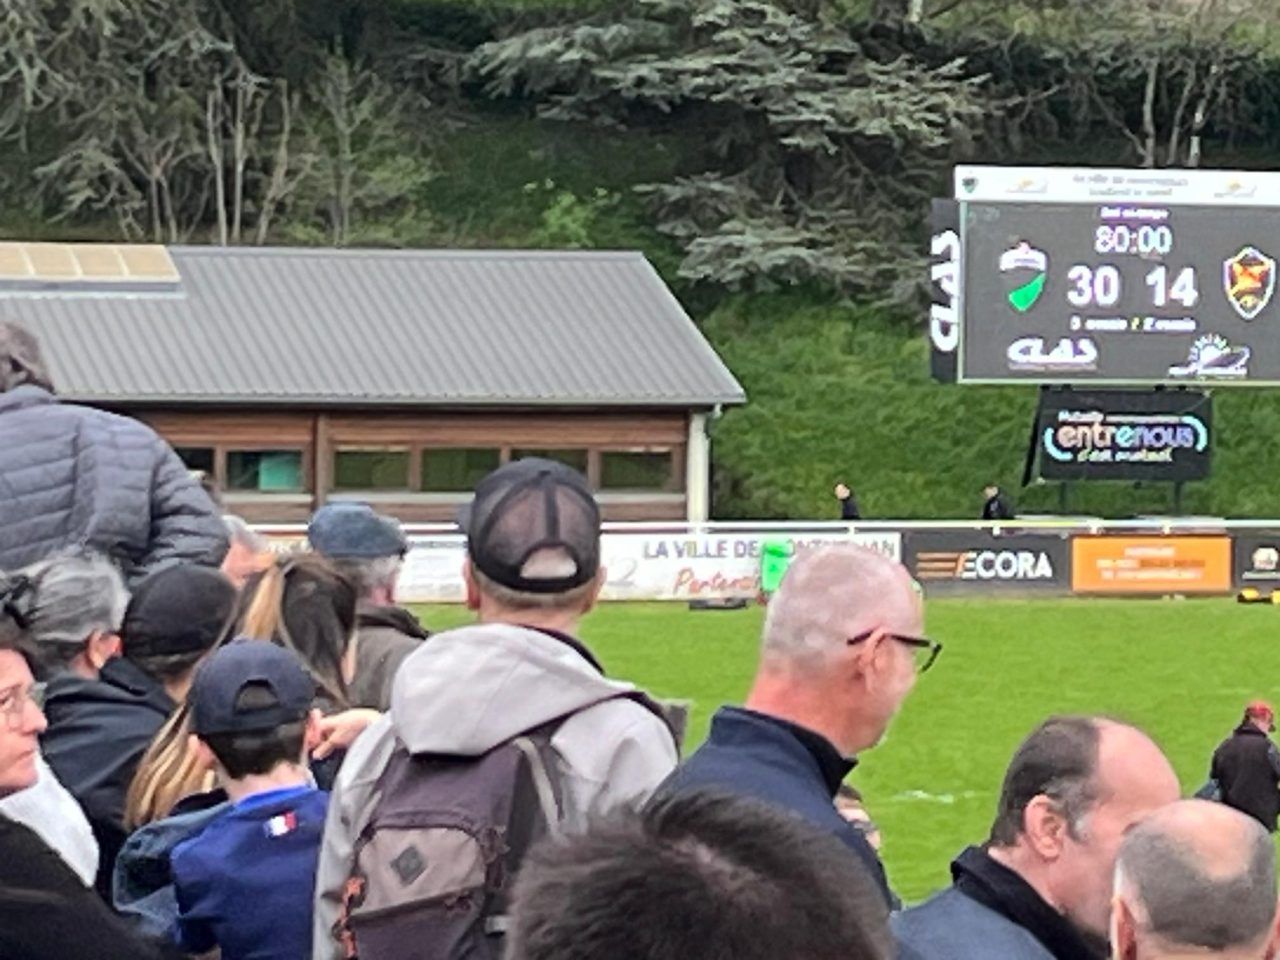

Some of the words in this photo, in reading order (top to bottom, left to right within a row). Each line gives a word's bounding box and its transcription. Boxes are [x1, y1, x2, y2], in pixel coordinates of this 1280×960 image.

[1095, 225, 1172, 253] 80:00
[931, 230, 959, 351] CLAS
[1067, 265, 1120, 306] 30
[1146, 266, 1199, 307] 14
[1007, 338, 1098, 364] CLAS
[1057, 423, 1194, 448] entrenous
[643, 541, 669, 558] LA
[673, 541, 728, 558] VILLE
[734, 541, 760, 558] DE
